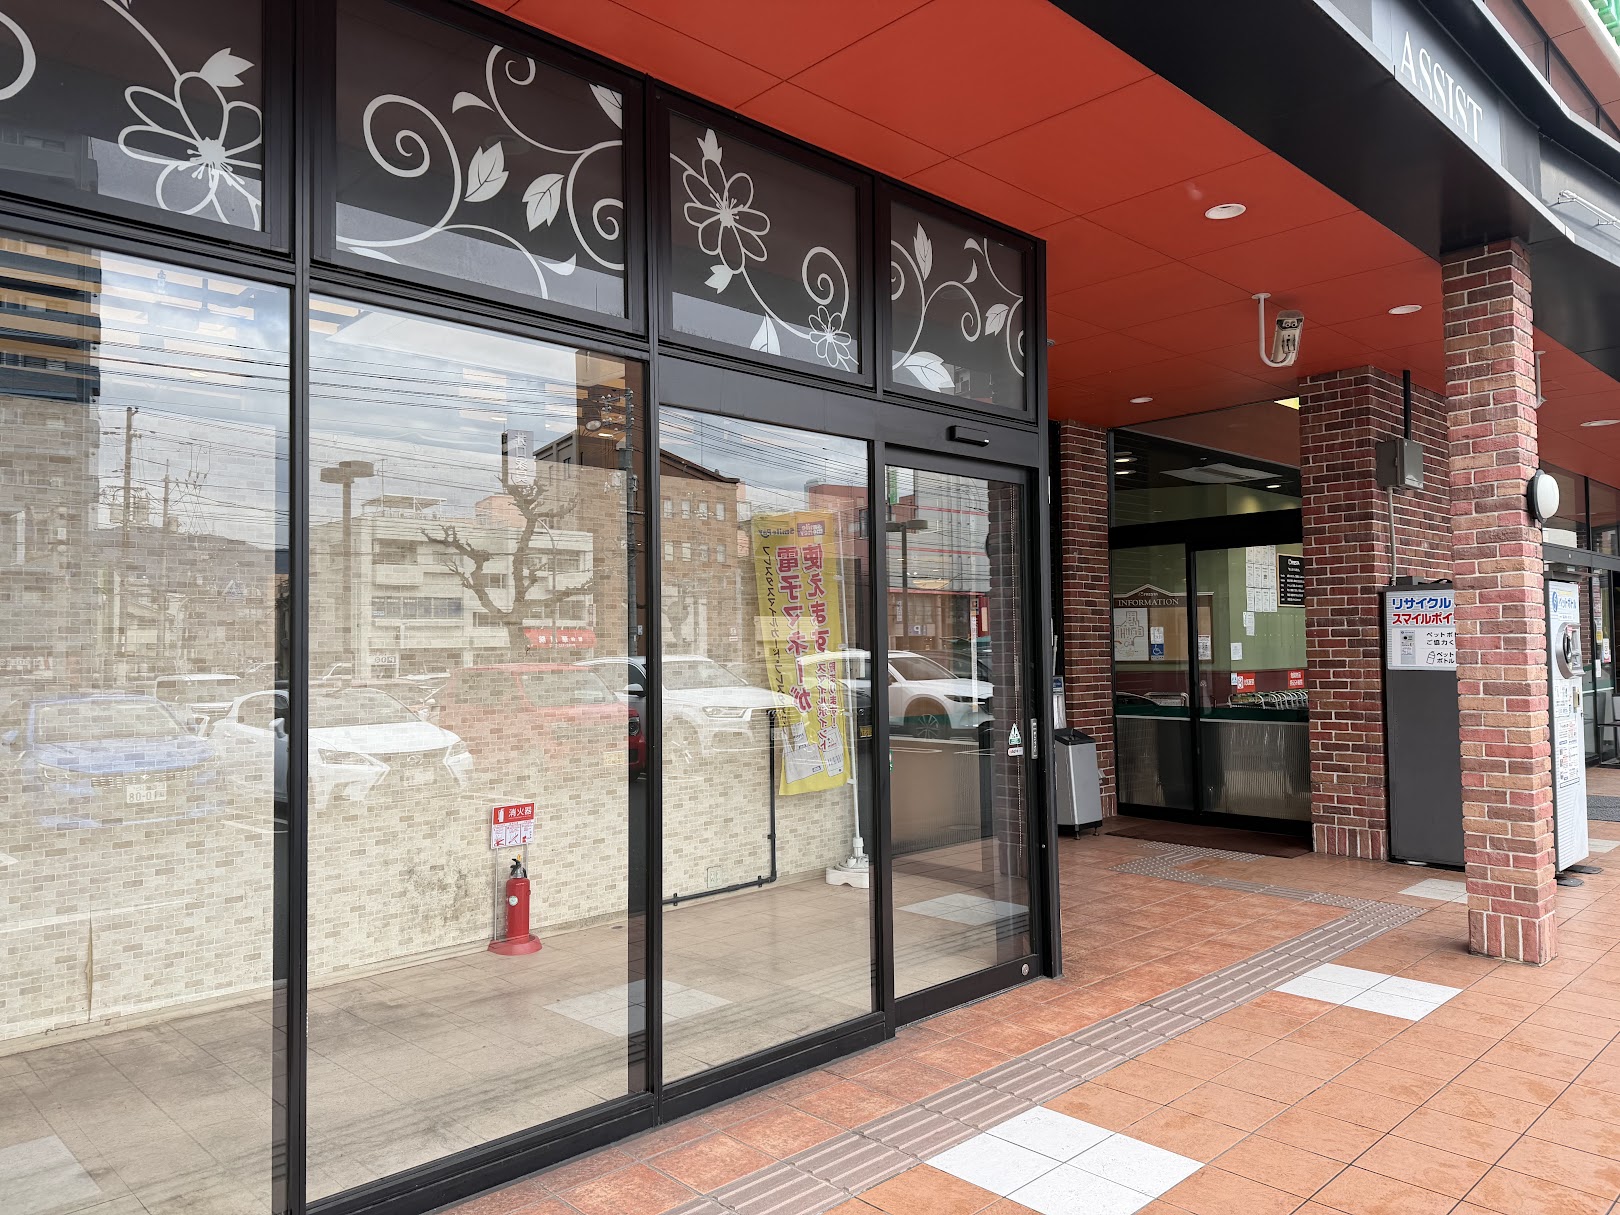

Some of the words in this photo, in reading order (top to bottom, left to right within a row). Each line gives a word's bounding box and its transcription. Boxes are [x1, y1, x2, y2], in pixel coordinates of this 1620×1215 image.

[1400, 31, 1483, 144] ASSIST
[1118, 598, 1179, 607] INFORMATION
[1392, 597, 1452, 610] リサイクル
[1392, 612, 1456, 625] スマイルポイ
[508, 806, 532, 817] 消火器
